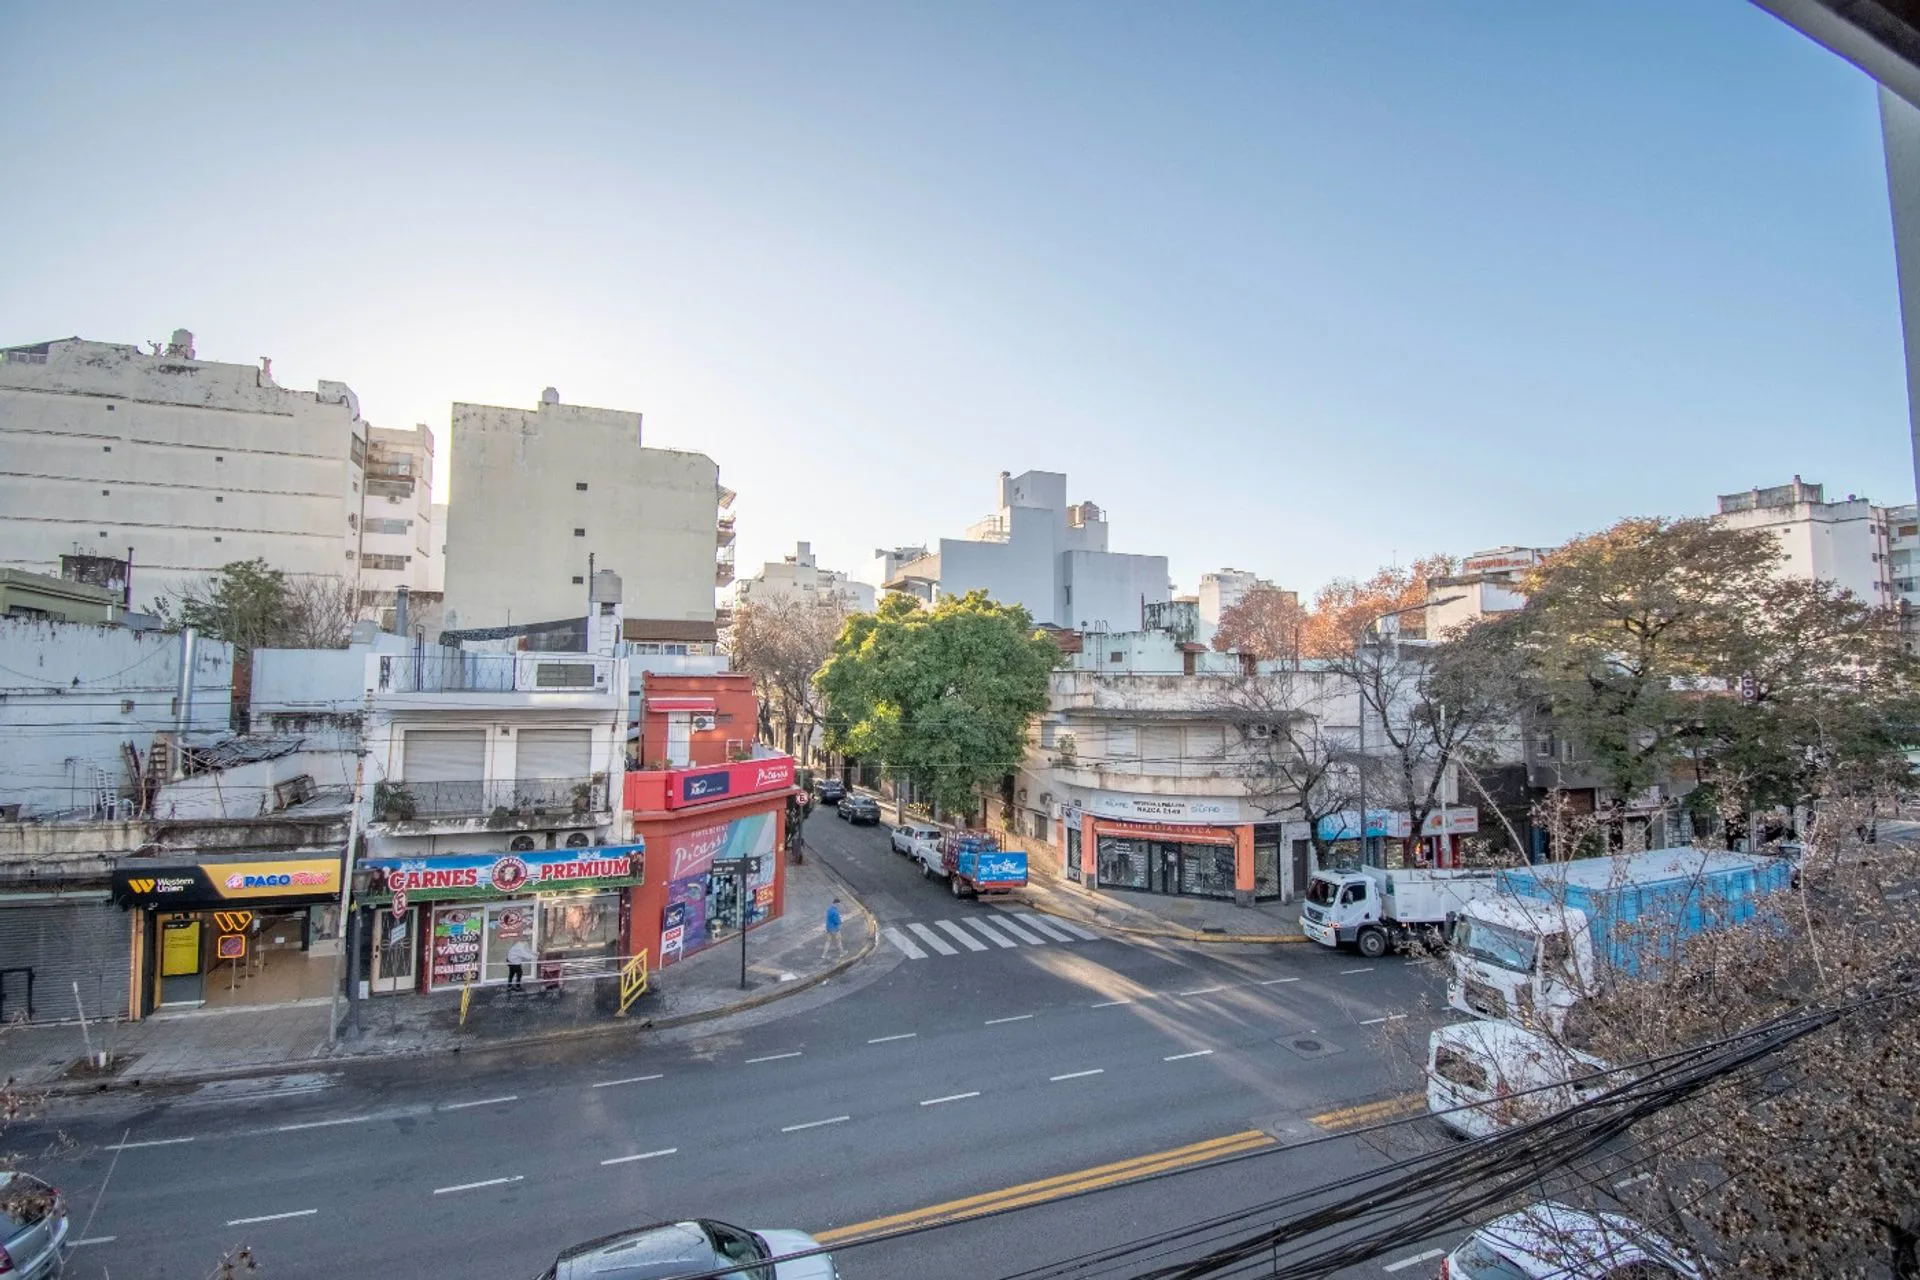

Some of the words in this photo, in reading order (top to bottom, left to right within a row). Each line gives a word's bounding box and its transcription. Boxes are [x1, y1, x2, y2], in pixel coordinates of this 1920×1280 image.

[673, 832, 729, 879] Picasso
[244, 872, 292, 887] PAGO
[388, 867, 478, 892] CARNES
[540, 856, 631, 881] PREMIUM
[156, 877, 194, 887] Western
[156, 884, 184, 893] Union
